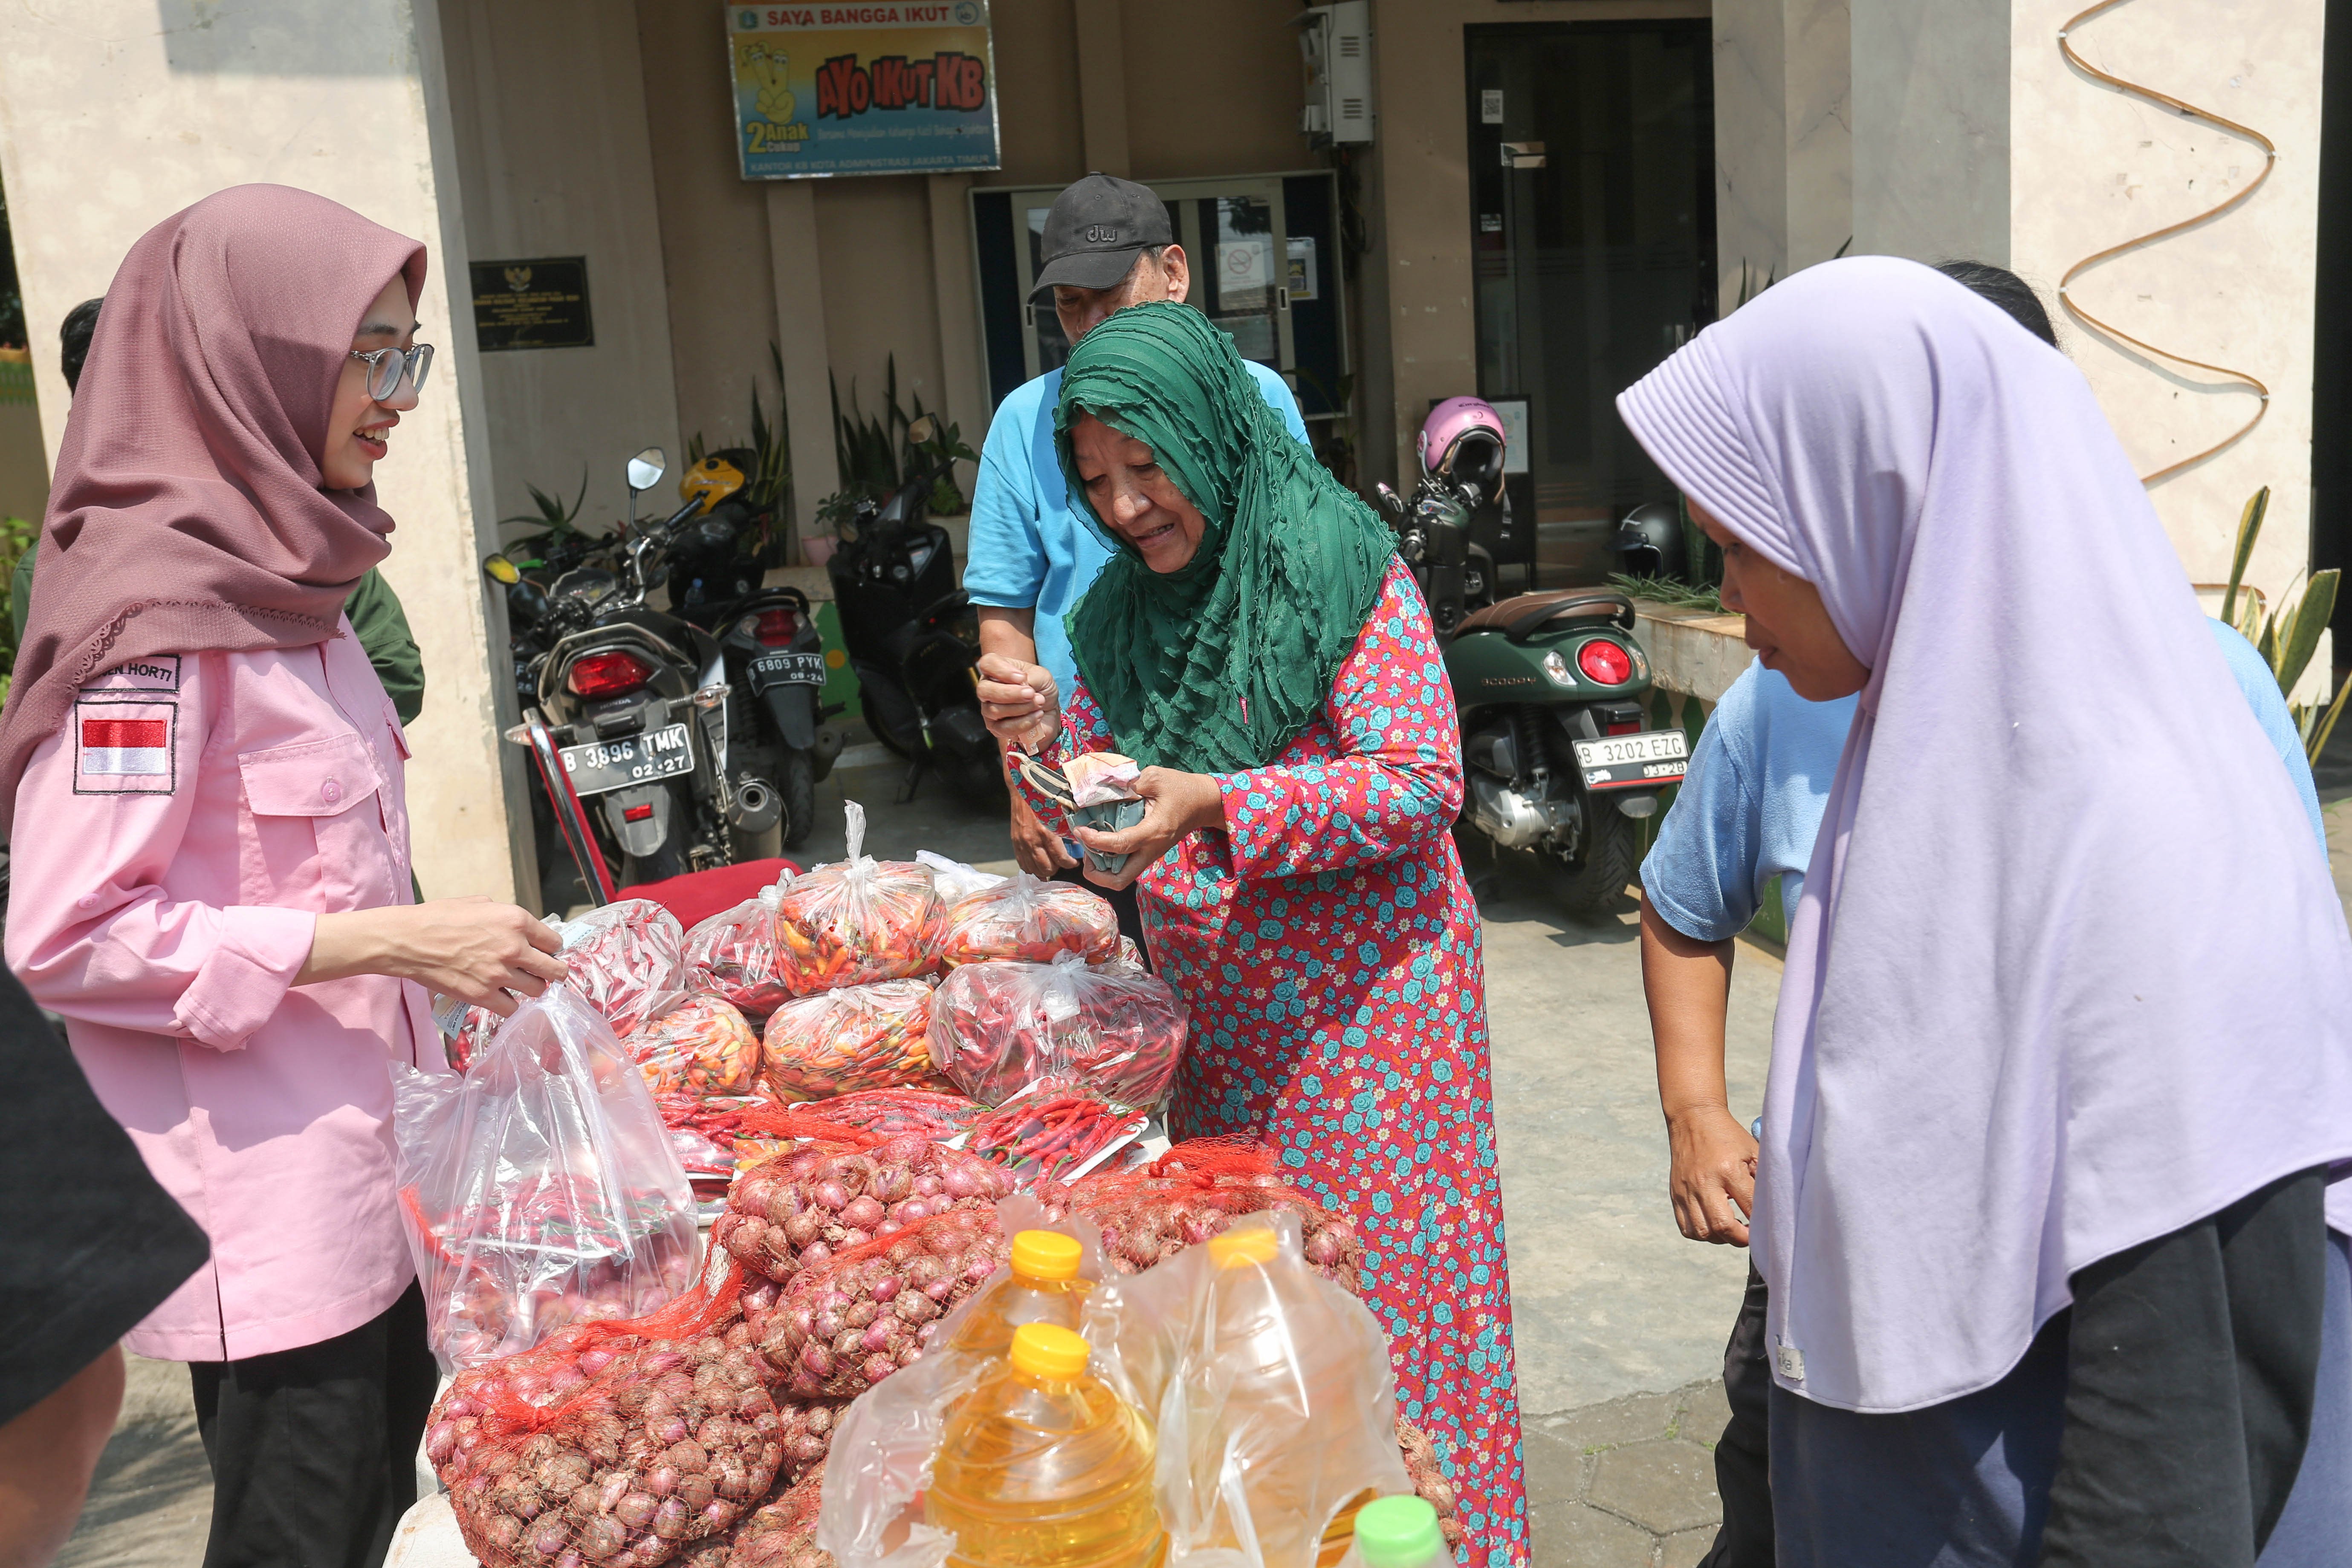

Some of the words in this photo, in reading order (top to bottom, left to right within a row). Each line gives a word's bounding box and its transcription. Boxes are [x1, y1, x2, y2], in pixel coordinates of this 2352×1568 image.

[767, 10, 815, 26] SAYA
[820, 8, 900, 24] BANGGA
[905, 6, 949, 22] IKUT
[816, 53, 870, 120] AYO
[871, 55, 934, 110] IKUT
[935, 52, 986, 112] KB
[746, 121, 767, 154] 2
[766, 122, 810, 141] Anak
[750, 162, 792, 171] KANTOR
[810, 160, 836, 170] KOTA
[839, 157, 911, 169] ADMINISTRASI
[912, 156, 955, 165] JAKARTA
[956, 154, 989, 164] TIMUR
[128, 663, 172, 682] HORTI
[757, 658, 791, 672] 6809
[797, 656, 822, 670] PYK
[599, 698, 631, 710] HONDA
[563, 752, 577, 772] B
[585, 741, 634, 768] 3896
[643, 726, 685, 753] TMK
[1581, 747, 1593, 764] B
[1604, 741, 1646, 762] 3202
[1651, 737, 1682, 757] EZG
